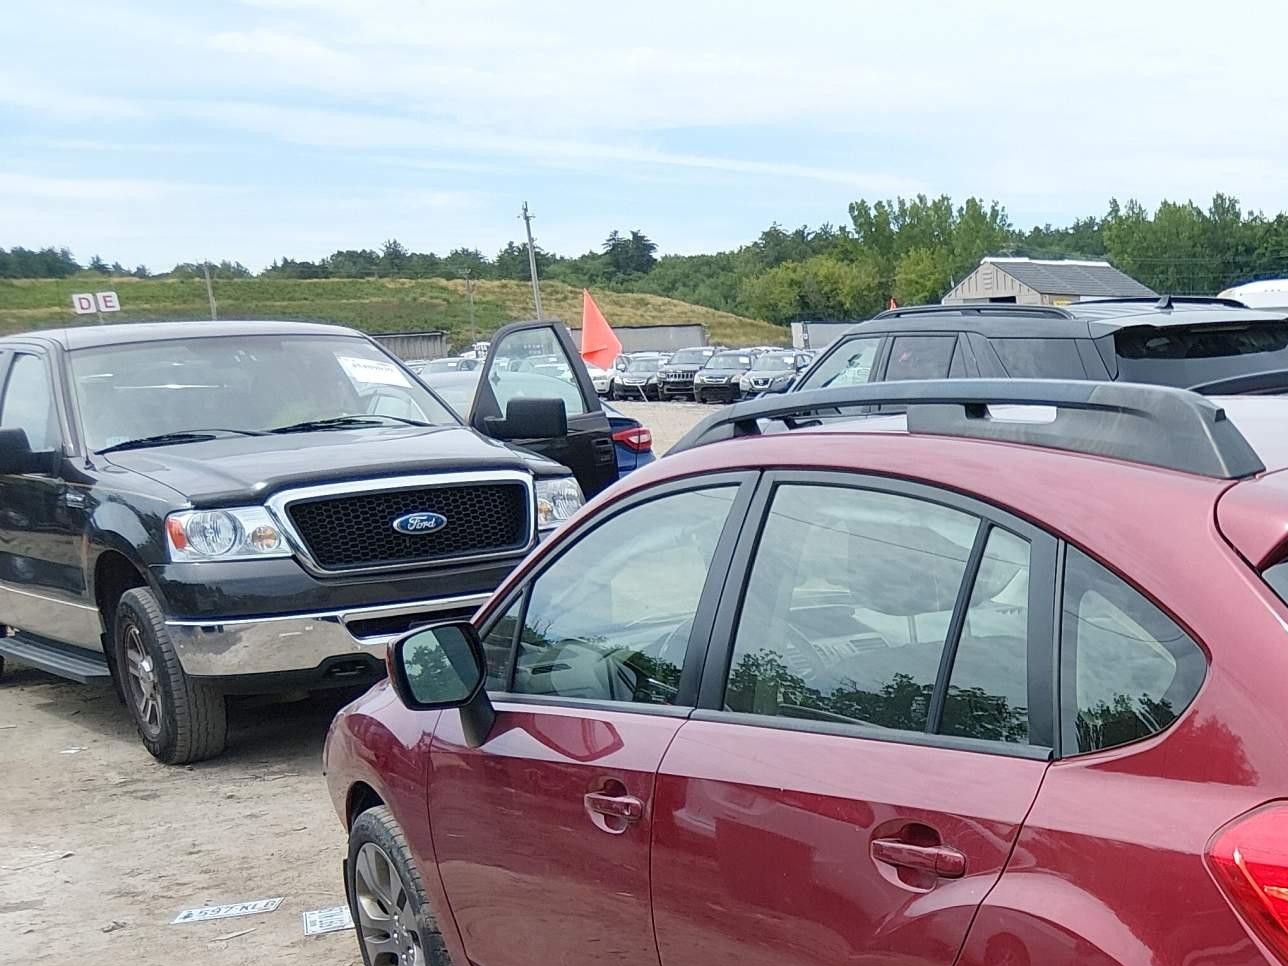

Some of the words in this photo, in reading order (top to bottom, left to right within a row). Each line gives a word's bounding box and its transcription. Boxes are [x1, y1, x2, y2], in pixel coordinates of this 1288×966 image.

[78, 297, 91, 310] D
[102, 295, 116, 308] E
[407, 516, 437, 530] Ford
